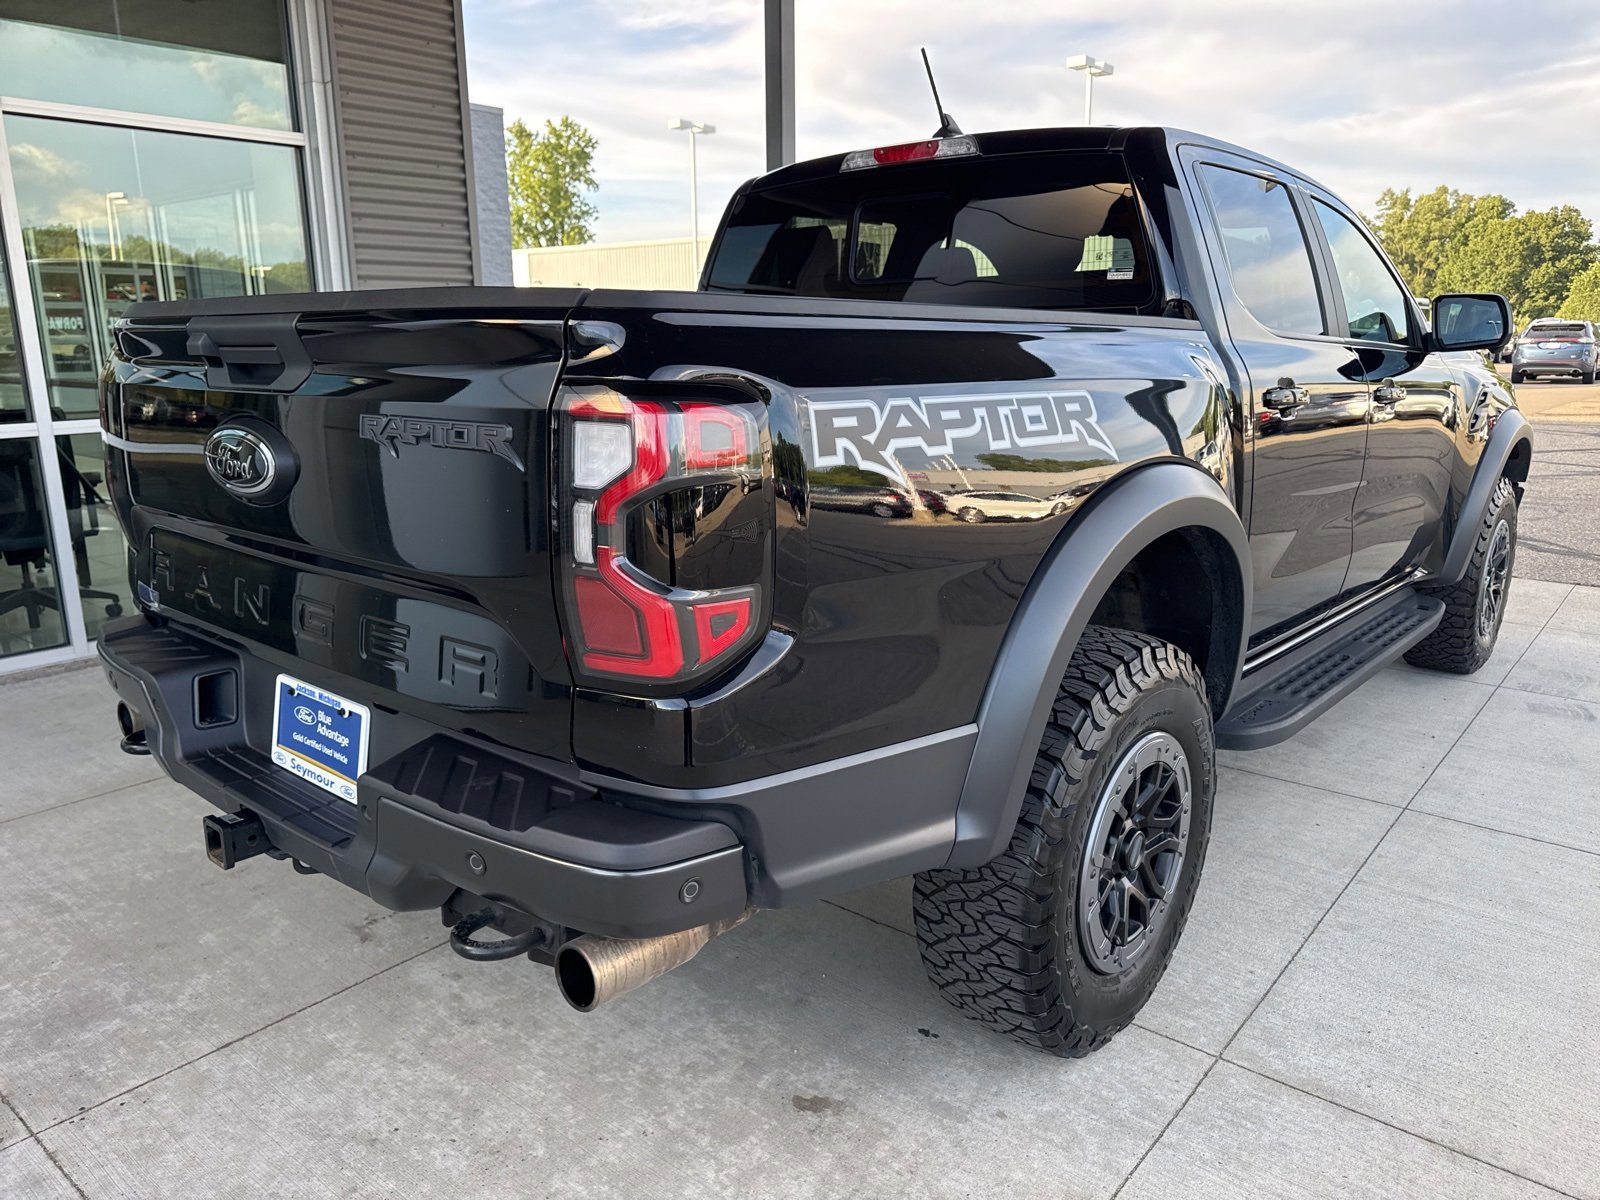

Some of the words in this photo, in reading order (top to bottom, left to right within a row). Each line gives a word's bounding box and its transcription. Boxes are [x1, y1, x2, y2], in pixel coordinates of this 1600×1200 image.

[360, 413, 525, 472] RAPTOR
[808, 390, 1120, 490] RAPTOR
[215, 442, 253, 479] Ford
[152, 547, 499, 698] RANGER
[297, 707, 314, 724] Ford
[318, 691, 341, 709] Michigan
[317, 710, 332, 726] Blue
[293, 732, 304, 743] Gold
[303, 736, 322, 751] Certified
[322, 744, 334, 757] Used
[333, 749, 349, 765] Vehicle
[317, 722, 350, 747] Advantage
[290, 757, 335, 788] Seymour
